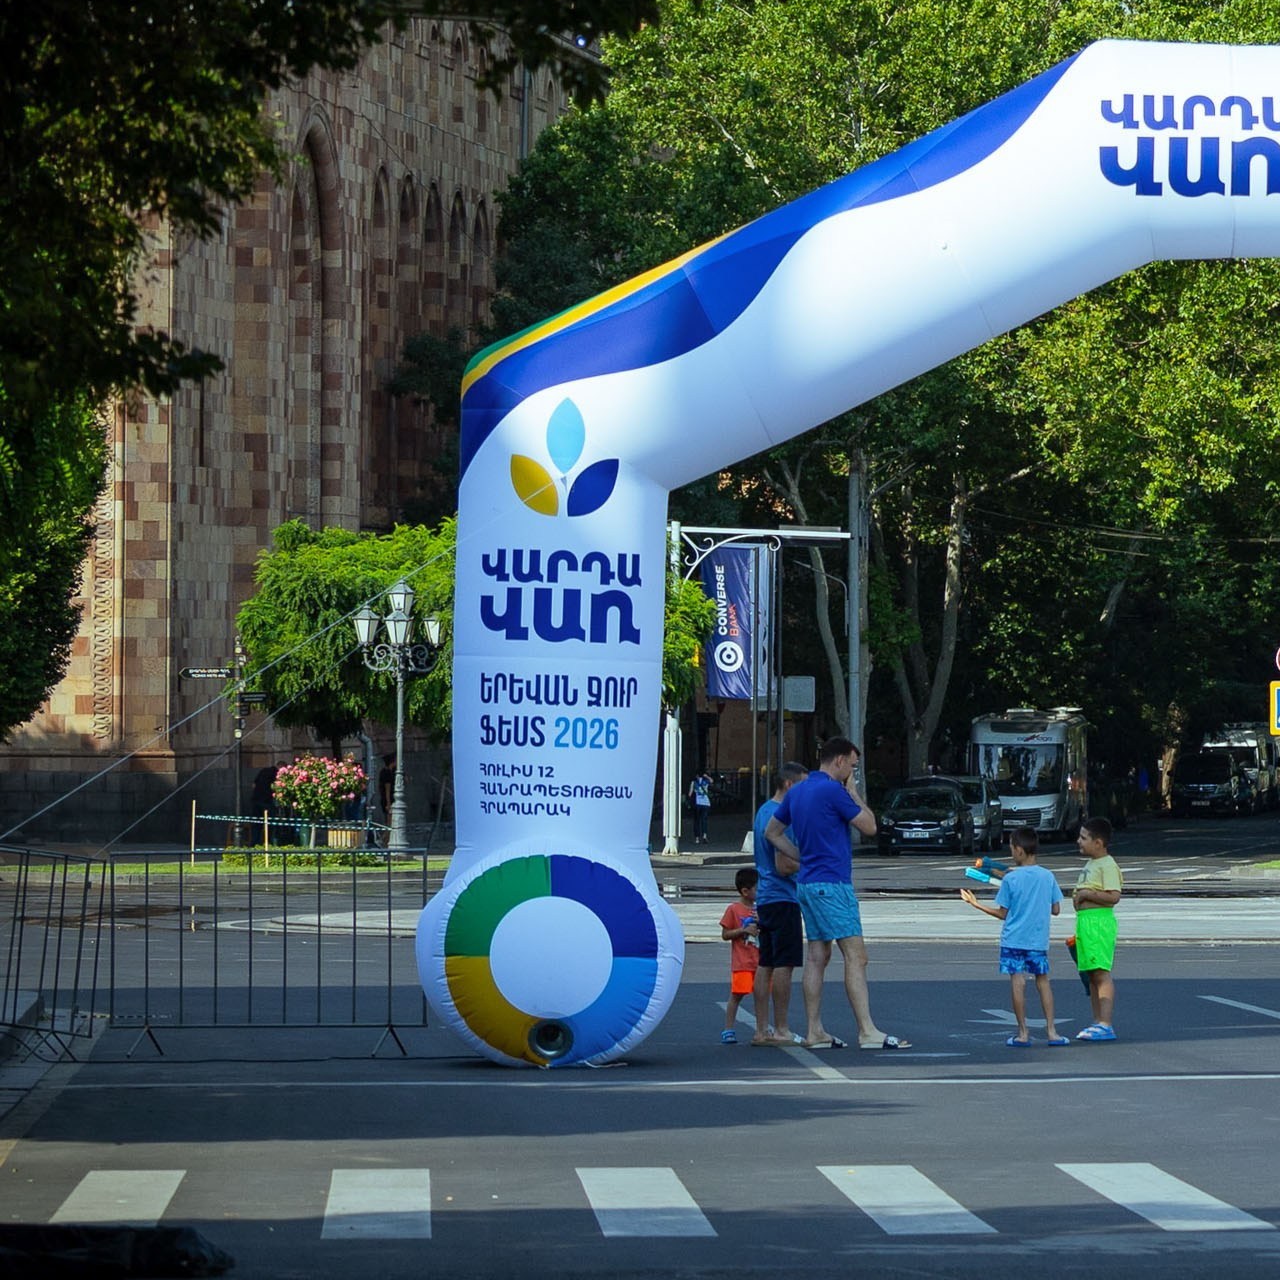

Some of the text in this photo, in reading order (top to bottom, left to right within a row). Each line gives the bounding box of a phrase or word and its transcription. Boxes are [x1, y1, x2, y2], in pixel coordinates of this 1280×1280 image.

[481, 548, 642, 587] ՎԱՐԴԱ
[480, 587, 641, 645] ՎԱՌ
[715, 565, 729, 636] CONVERSE
[480, 672, 638, 708] ԵՐԵՎԱՆ ՋՈՒՐ
[480, 714, 619, 750] ՖԵՍՏ 2026
[480, 763, 555, 778] ՀՈՒԼԻՍ 12
[480, 782, 633, 799] ՀԱՆՐԱՊԵՏՈՒԹՅԱՆ
[480, 801, 571, 816] ՀՐԱՊԱՐԱԿ
